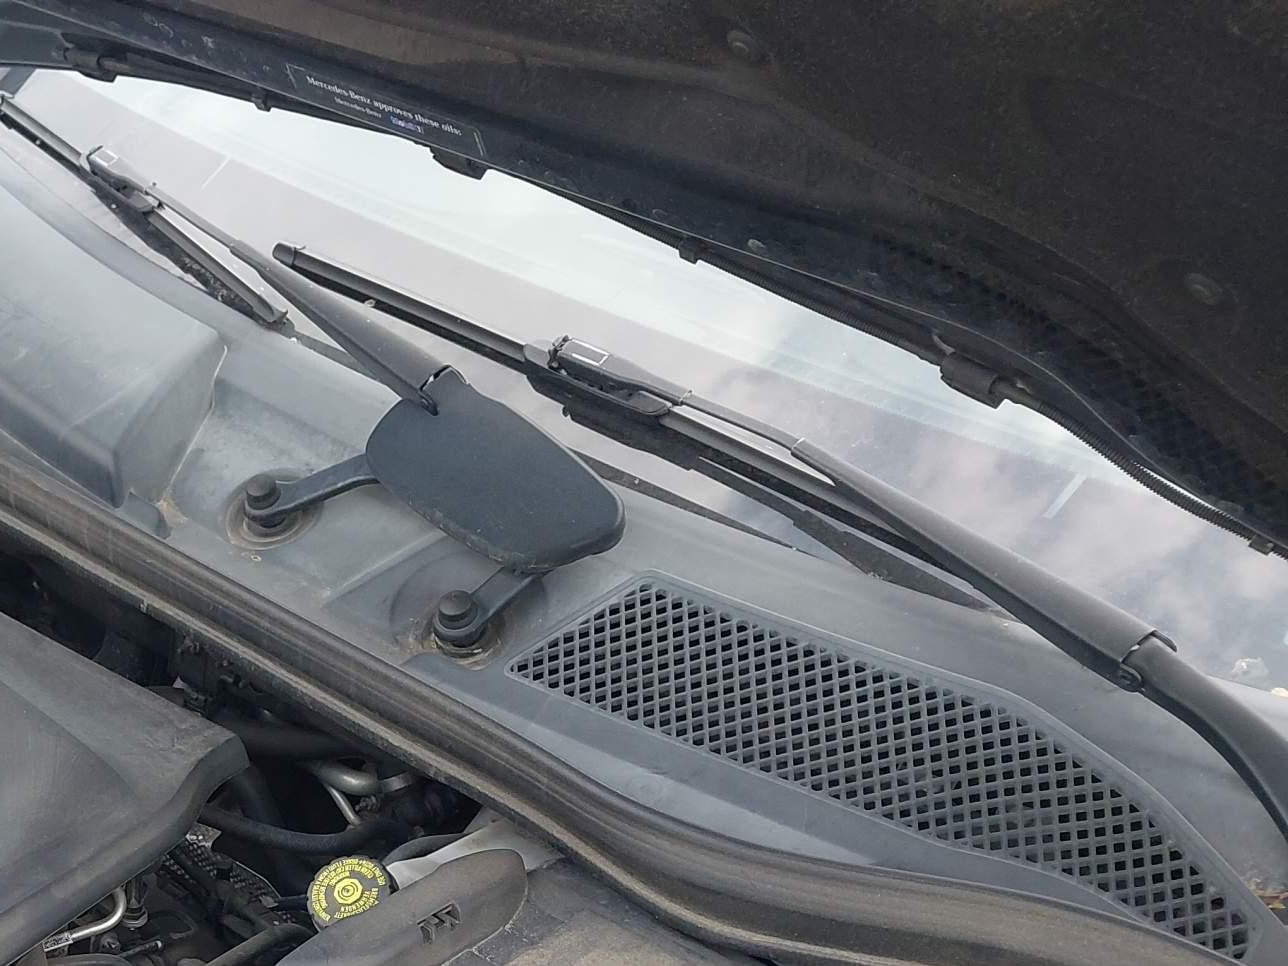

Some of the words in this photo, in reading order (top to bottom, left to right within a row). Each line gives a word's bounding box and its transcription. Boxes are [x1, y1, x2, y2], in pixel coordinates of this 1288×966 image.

[306, 75, 372, 104] Mercedes-Benz
[373, 100, 414, 120] approves
[414, 113, 440, 129] these
